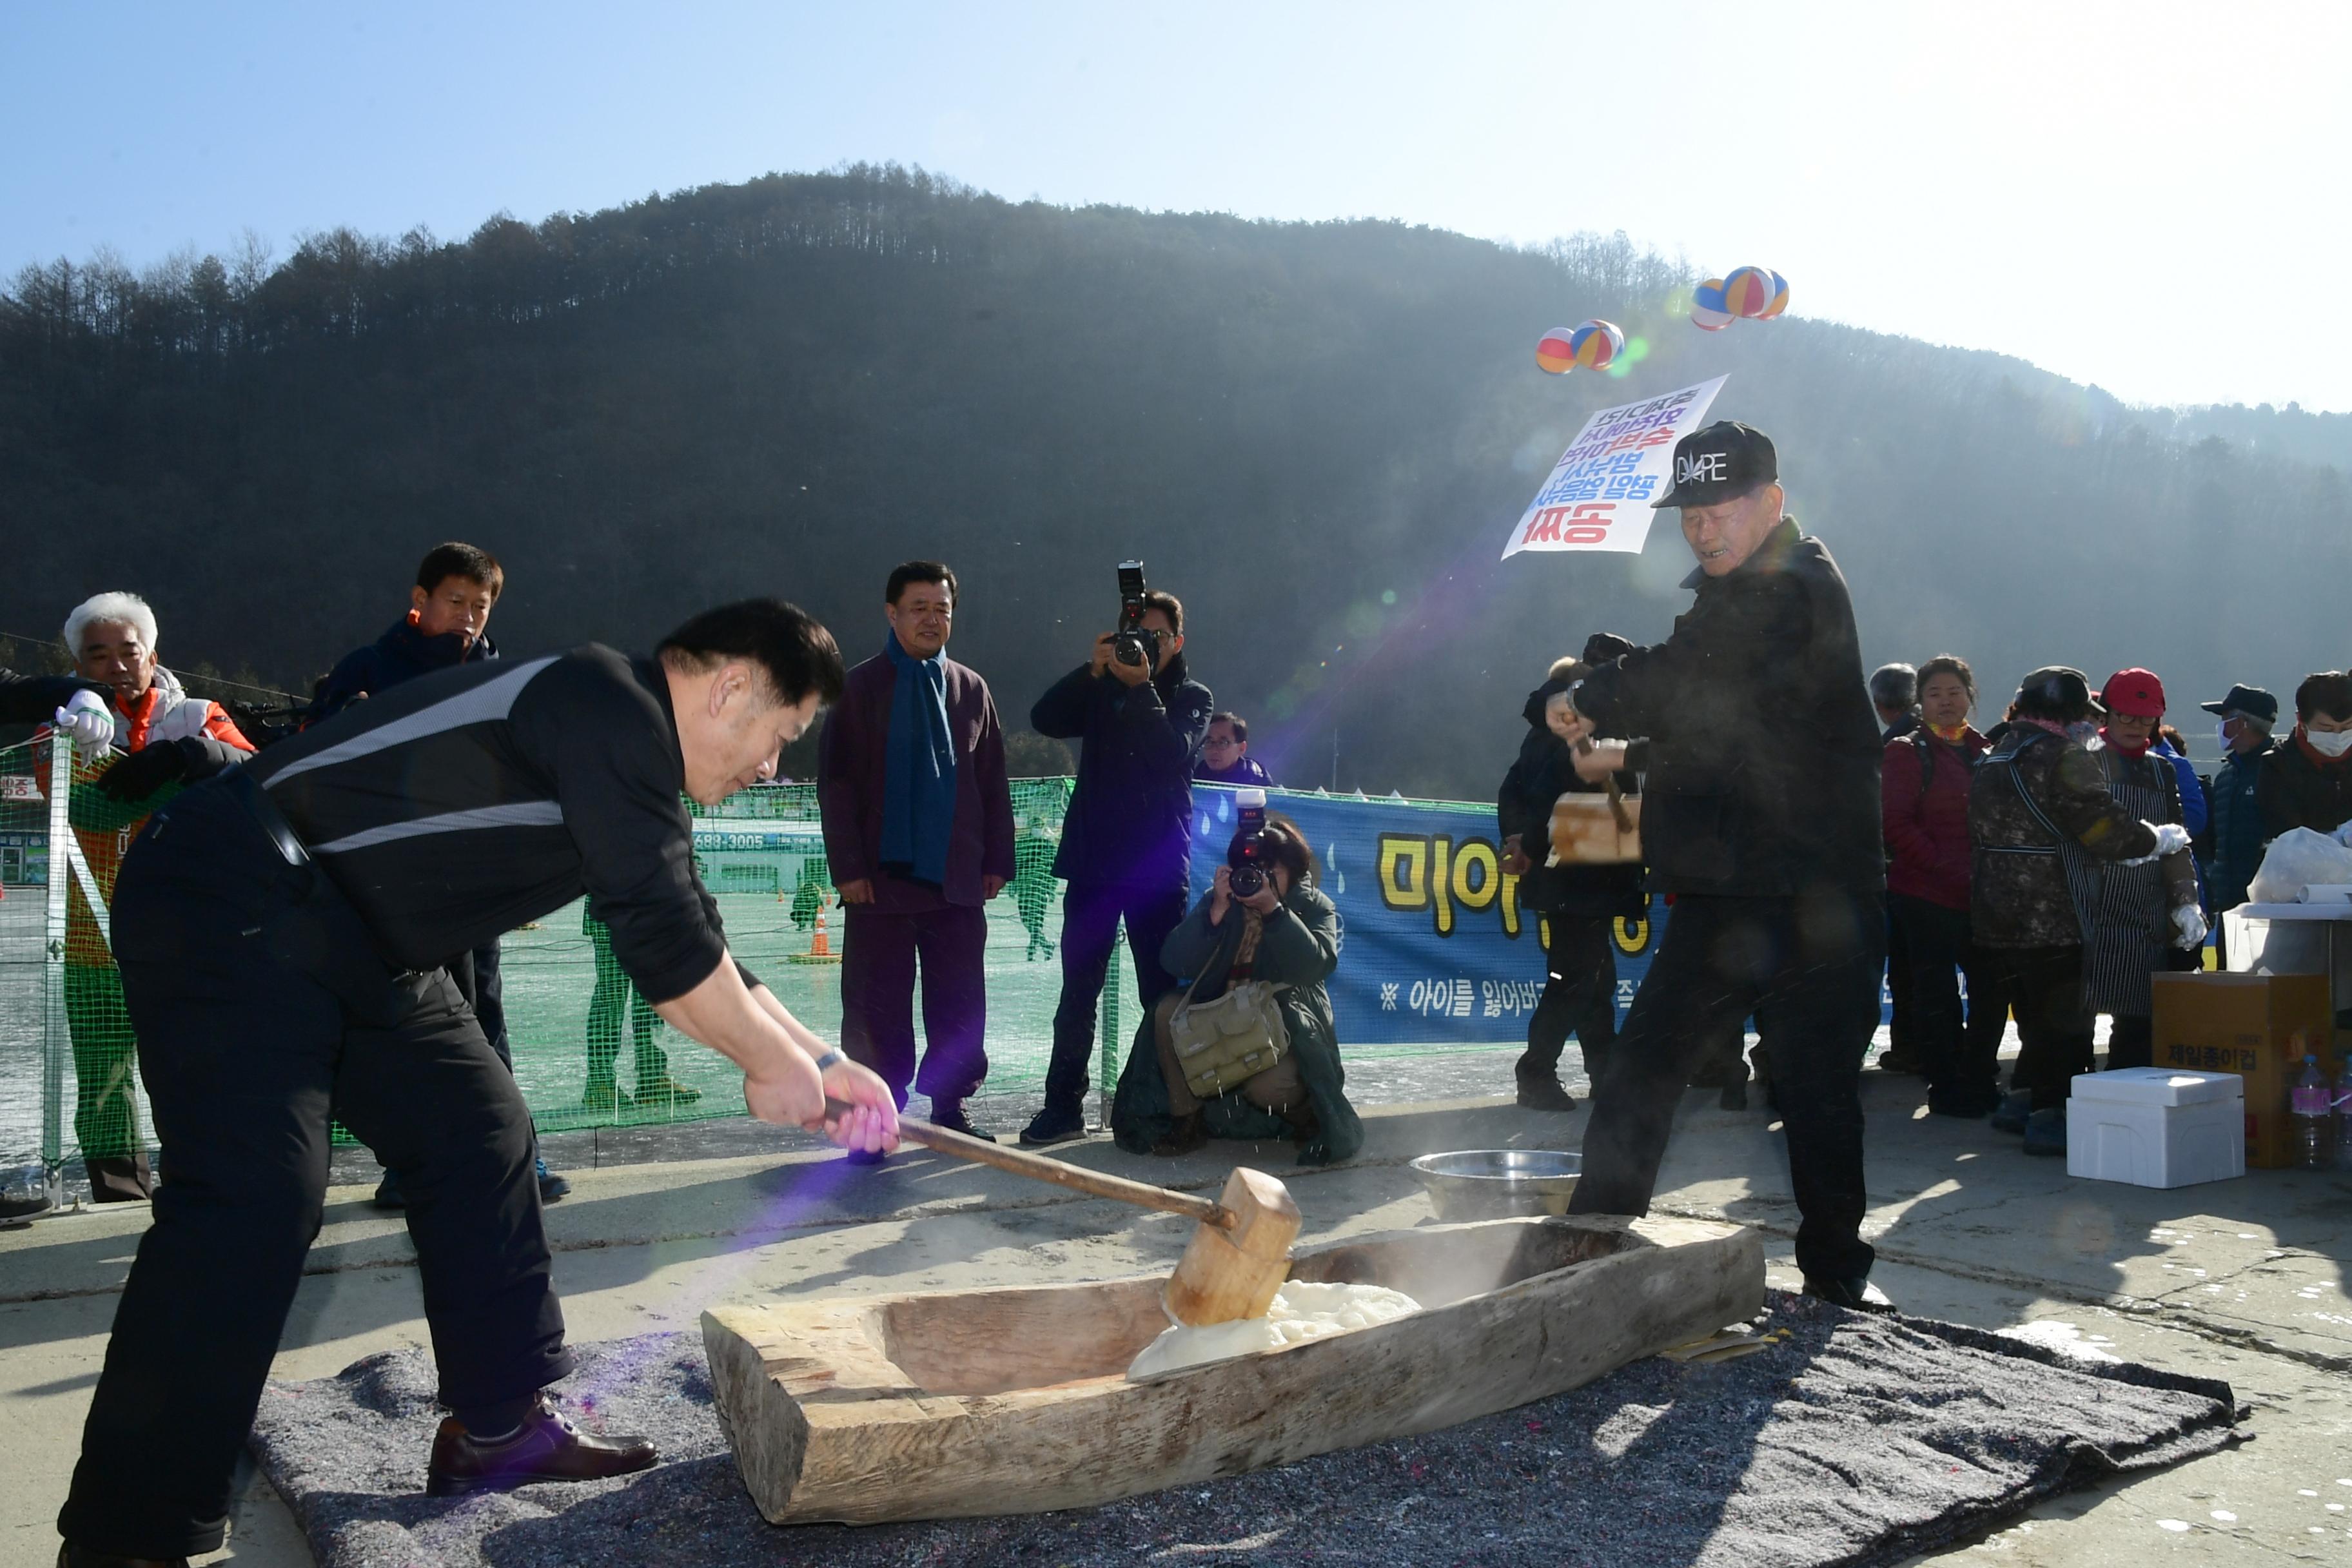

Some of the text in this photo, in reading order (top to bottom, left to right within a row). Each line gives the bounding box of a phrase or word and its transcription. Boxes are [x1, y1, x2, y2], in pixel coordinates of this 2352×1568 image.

[1409, 978, 1475, 1017] 아이를
[1482, 980, 1546, 1017] 잃어버
[2169, 1044, 2256, 1070] 제일종이컵
